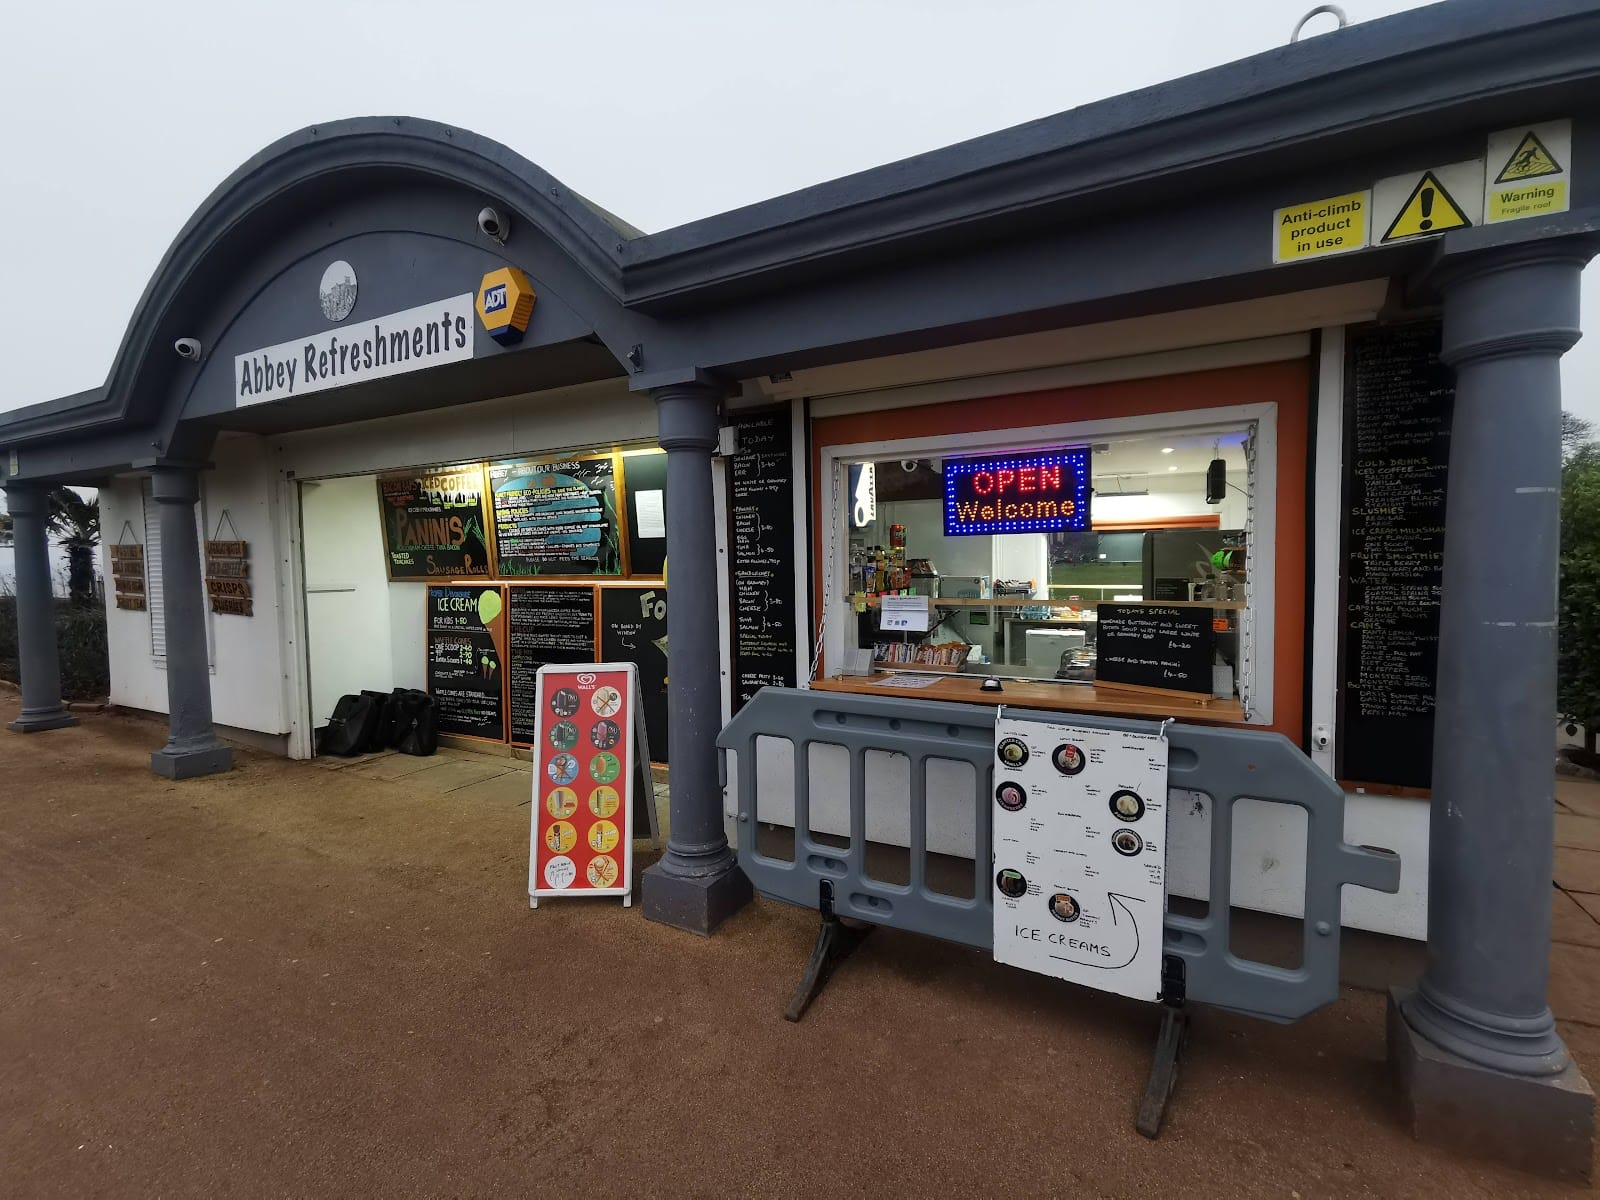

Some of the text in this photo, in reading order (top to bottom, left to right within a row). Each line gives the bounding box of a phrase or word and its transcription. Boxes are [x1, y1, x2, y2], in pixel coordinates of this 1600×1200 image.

[1500, 186, 1554, 204] Warning
[1281, 200, 1361, 226] Anti-climb
[1501, 200, 1552, 216] Fragile roof
[1291, 217, 1351, 240] product
[1297, 235, 1344, 252] in use
[485, 287, 506, 310] ADT
[240, 312, 466, 396] Abbey Refreshments
[517, 466, 536, 476] ABOUT
[536, 464, 551, 473] OUR
[552, 461, 580, 472] BUSINESS
[1390, 457, 1428, 466] DRINKS
[1377, 466, 1415, 474] COFFEE
[974, 464, 1062, 495] OPEN
[956, 498, 1075, 522] Welcome
[1352, 507, 1405, 516] SLUSHIES
[395, 510, 466, 547] PANINIS
[426, 553, 489, 575] SAUSAGE ROLLS
[1350, 552, 1382, 560] FRUIT
[211, 581, 245, 595] CRISPS
[1350, 576, 1388, 585] WATER
[437, 597, 478, 613] ICE CREAM
[1148, 608, 1180, 616] SPECIAL
[433, 616, 444, 625] FOR
[443, 616, 454, 625] KIDS
[1350, 621, 1381, 630] CANS
[1347, 681, 1392, 691] BOTTLES
[1014, 925, 1111, 957] ICE CREAMS
